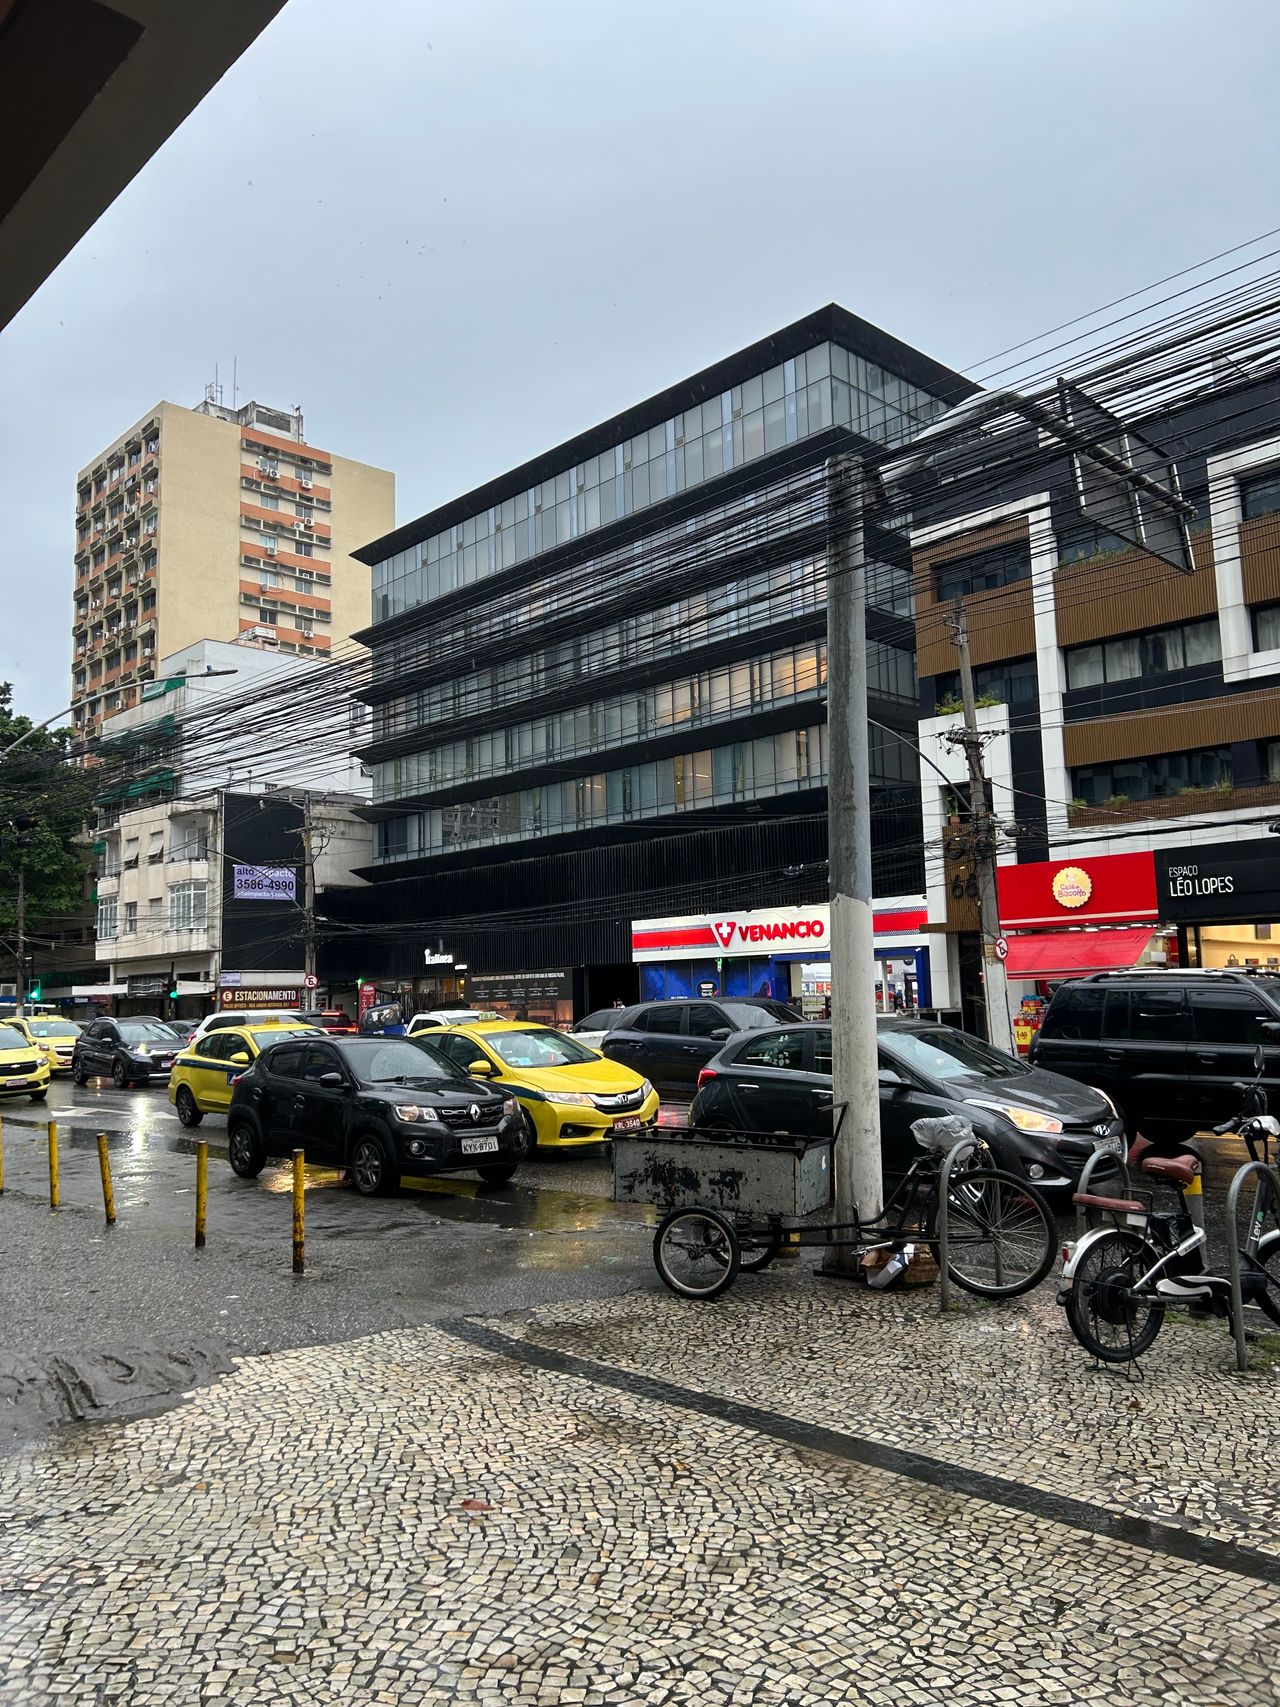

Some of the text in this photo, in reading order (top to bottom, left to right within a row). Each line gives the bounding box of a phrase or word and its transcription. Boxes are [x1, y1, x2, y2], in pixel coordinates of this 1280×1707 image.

[237, 867, 254, 876] alto
[1168, 865, 1198, 877] ESPAÇO
[237, 879, 294, 891] 3586-4990
[1169, 876, 1234, 897] LÉO LOPES
[738, 919, 825, 942] VENANCIO
[235, 990, 296, 1001] ESTACIONAMENTO
[1250, 1221, 1262, 1242] Lev
